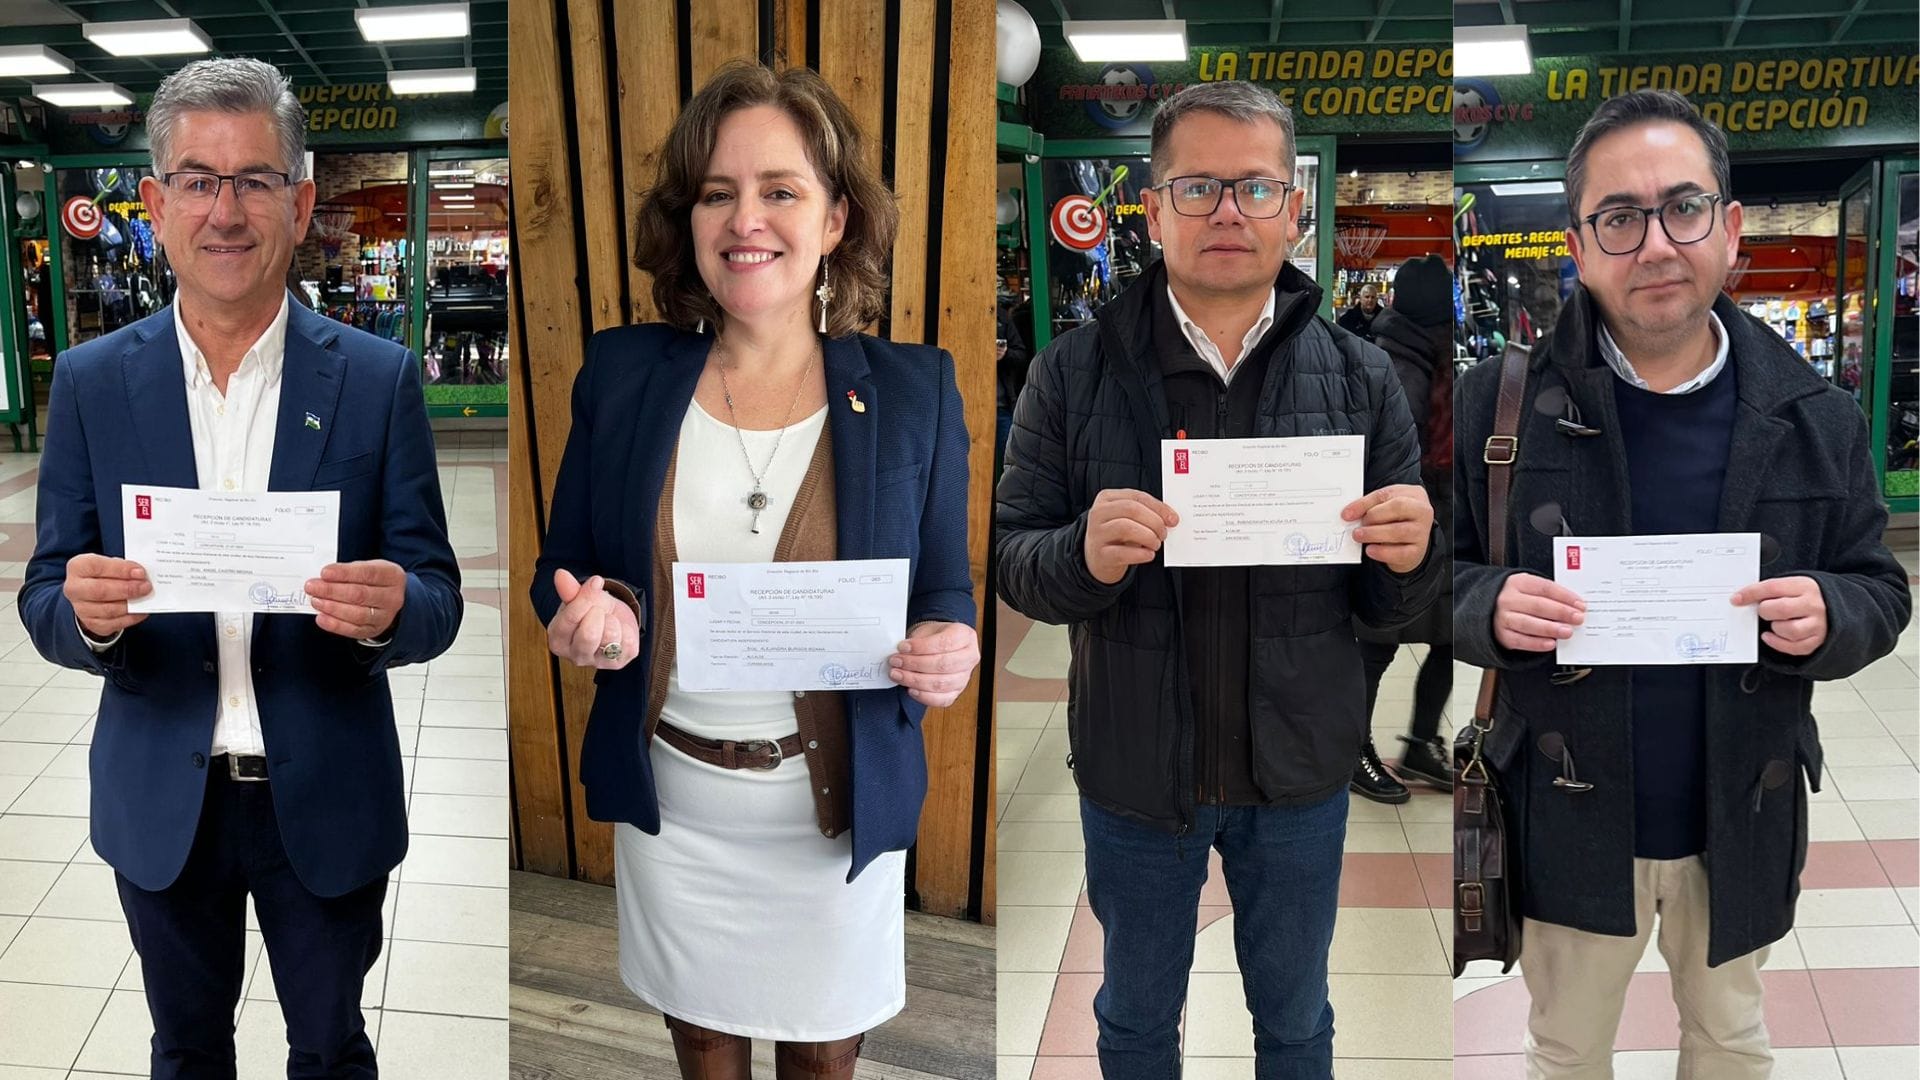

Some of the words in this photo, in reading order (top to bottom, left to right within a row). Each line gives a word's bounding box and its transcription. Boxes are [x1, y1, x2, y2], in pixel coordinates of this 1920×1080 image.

[1199, 52, 1238, 81] LA
[1248, 50, 1365, 80] TIENDA
[1547, 68, 1588, 101] LA
[1462, 233, 1523, 247] DEPORTES
[1504, 246, 1550, 260] MENAJE
[689, 575, 702, 585] SER
[695, 585, 702, 594] EL
